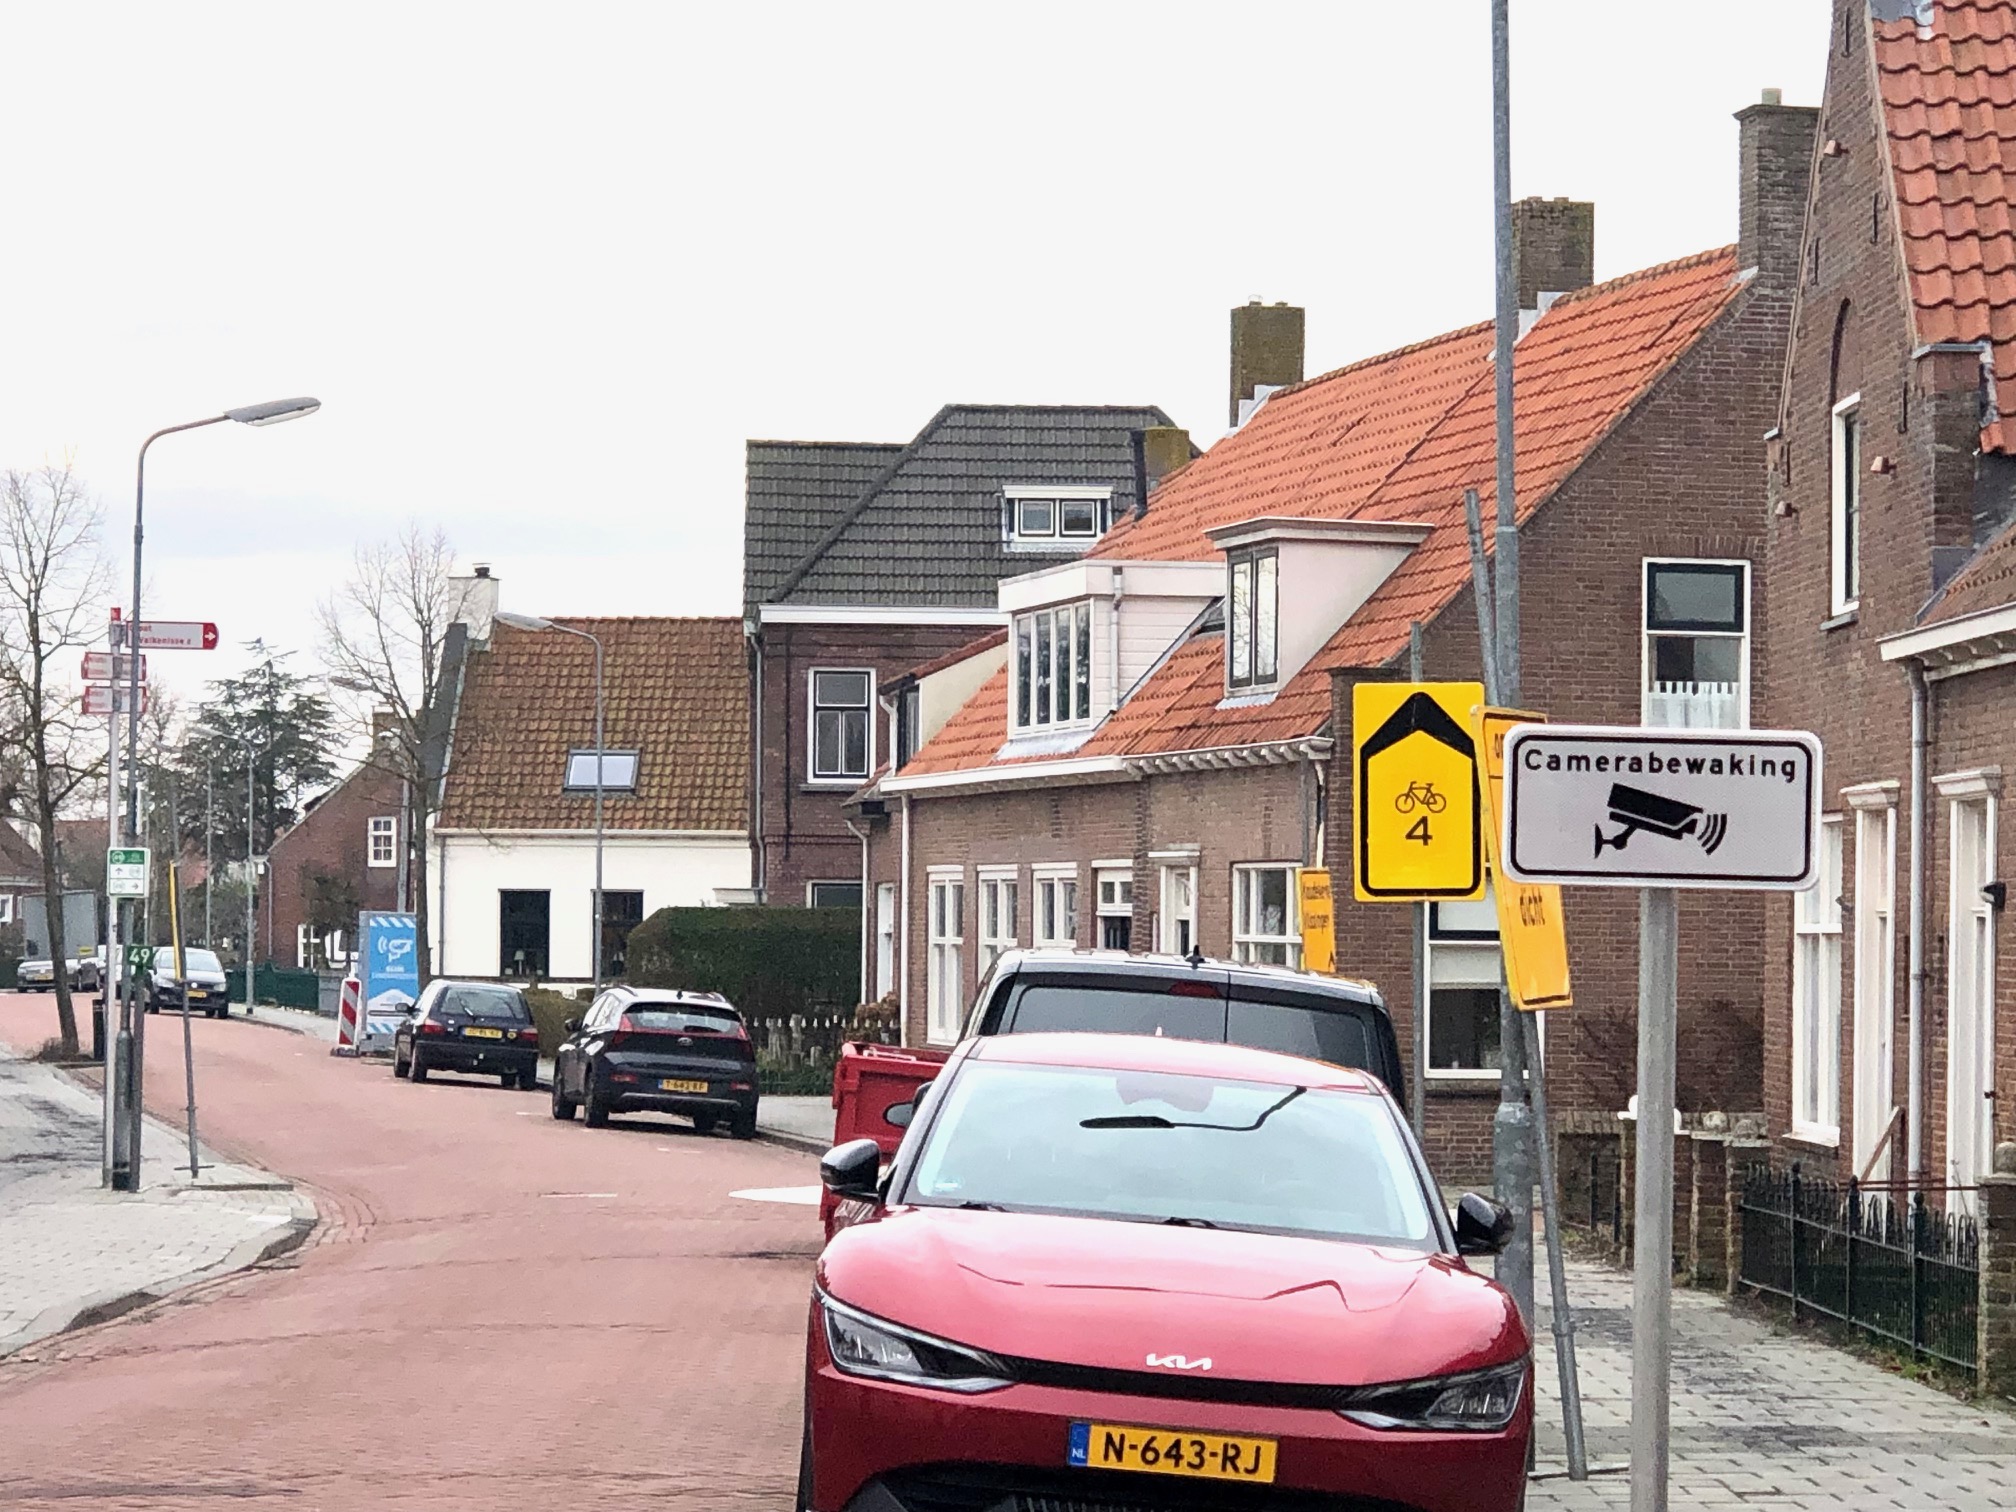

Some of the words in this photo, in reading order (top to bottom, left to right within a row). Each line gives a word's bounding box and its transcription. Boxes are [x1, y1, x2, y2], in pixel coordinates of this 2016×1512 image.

[1524, 749, 1796, 783] Camerabewaking
[1405, 815, 1433, 846] 4
[129, 948, 151, 964] 49
[1072, 1447, 1086, 1459] NL
[1103, 1431, 1262, 1475] N-643-RJ
